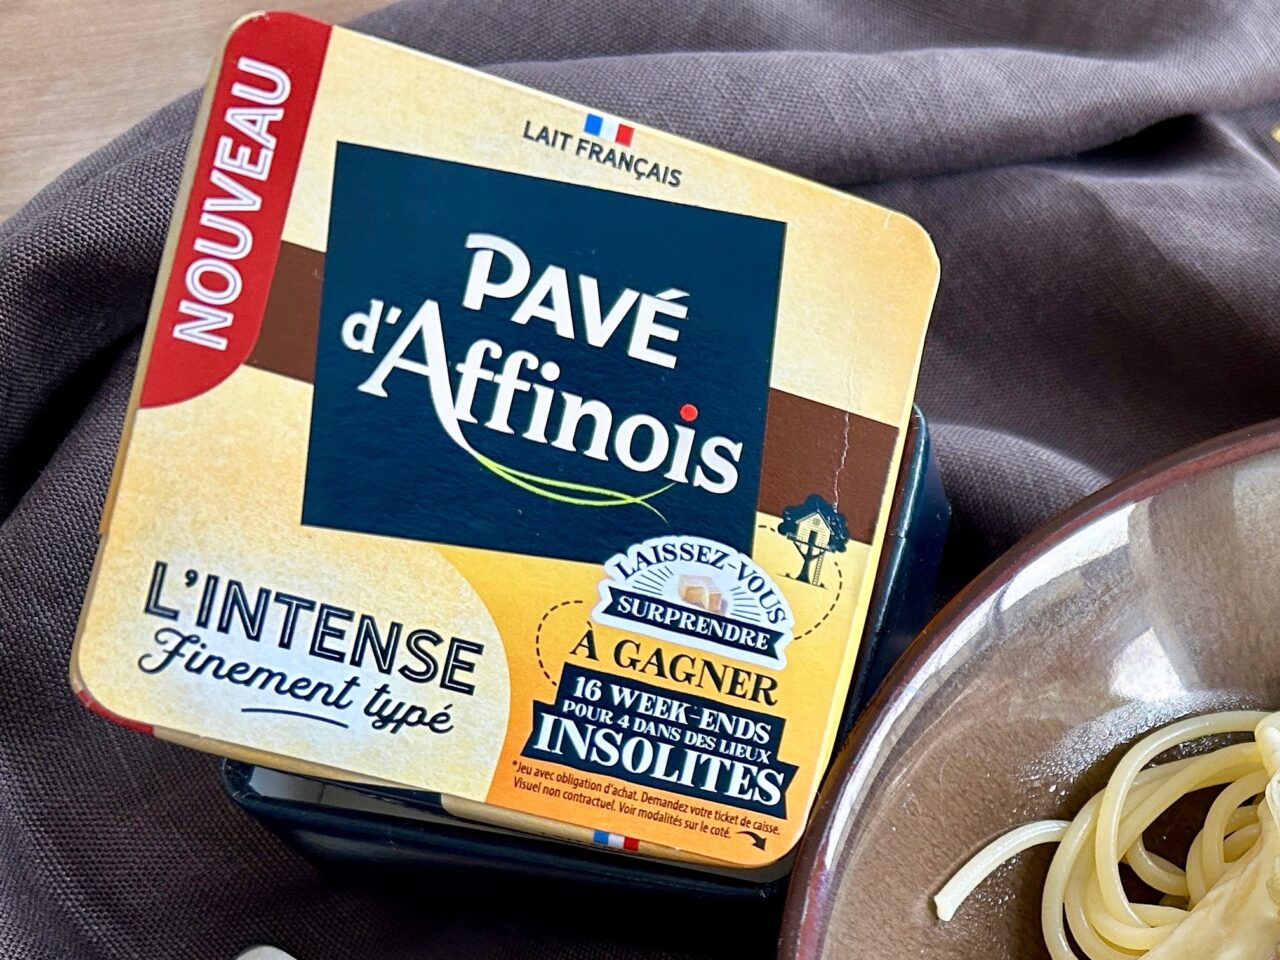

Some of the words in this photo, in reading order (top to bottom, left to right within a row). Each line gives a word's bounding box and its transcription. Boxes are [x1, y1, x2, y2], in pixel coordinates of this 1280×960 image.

[523, 120, 573, 151] LAIT
[575, 138, 682, 188] FRANÇAIS
[172, 57, 293, 351] NOUVEAU
[462, 231, 691, 369] PAVÉ
[341, 297, 744, 496] d'Affinois
[614, 543, 787, 625] LAISSEZ-VOUS
[617, 596, 770, 650] SURPRENDRE
[144, 561, 485, 696] L'INTENSE
[569, 621, 599, 661] À
[613, 639, 779, 706] GAGNER
[138, 627, 360, 709] Finement
[363, 682, 455, 735] typé
[573, 676, 603, 702] 16
[610, 684, 772, 745] WEEK-ENDS
[532, 713, 786, 807] INSOLITES
[562, 699, 614, 725] POUR
[617, 714, 630, 729] 4
[633, 718, 681, 742] DANS
[684, 731, 717, 750] DES
[719, 741, 771, 764] LIEUX
[513, 776, 542, 793] Visuel
[542, 785, 560, 798] non
[562, 790, 616, 812] contractuel.
[619, 801, 638, 815] Voir
[638, 808, 683, 827] modalités
[684, 819, 699, 830] sur
[700, 820, 709, 833] le
[533, 768, 554, 781] avec
[556, 771, 602, 792] obligation
[603, 784, 638, 801] d'achat.
[641, 791, 689, 812] Demandez
[690, 805, 713, 819] votre
[713, 810, 739, 825] ticket
[740, 816, 752, 828] de
[752, 821, 780, 835] caisse.
